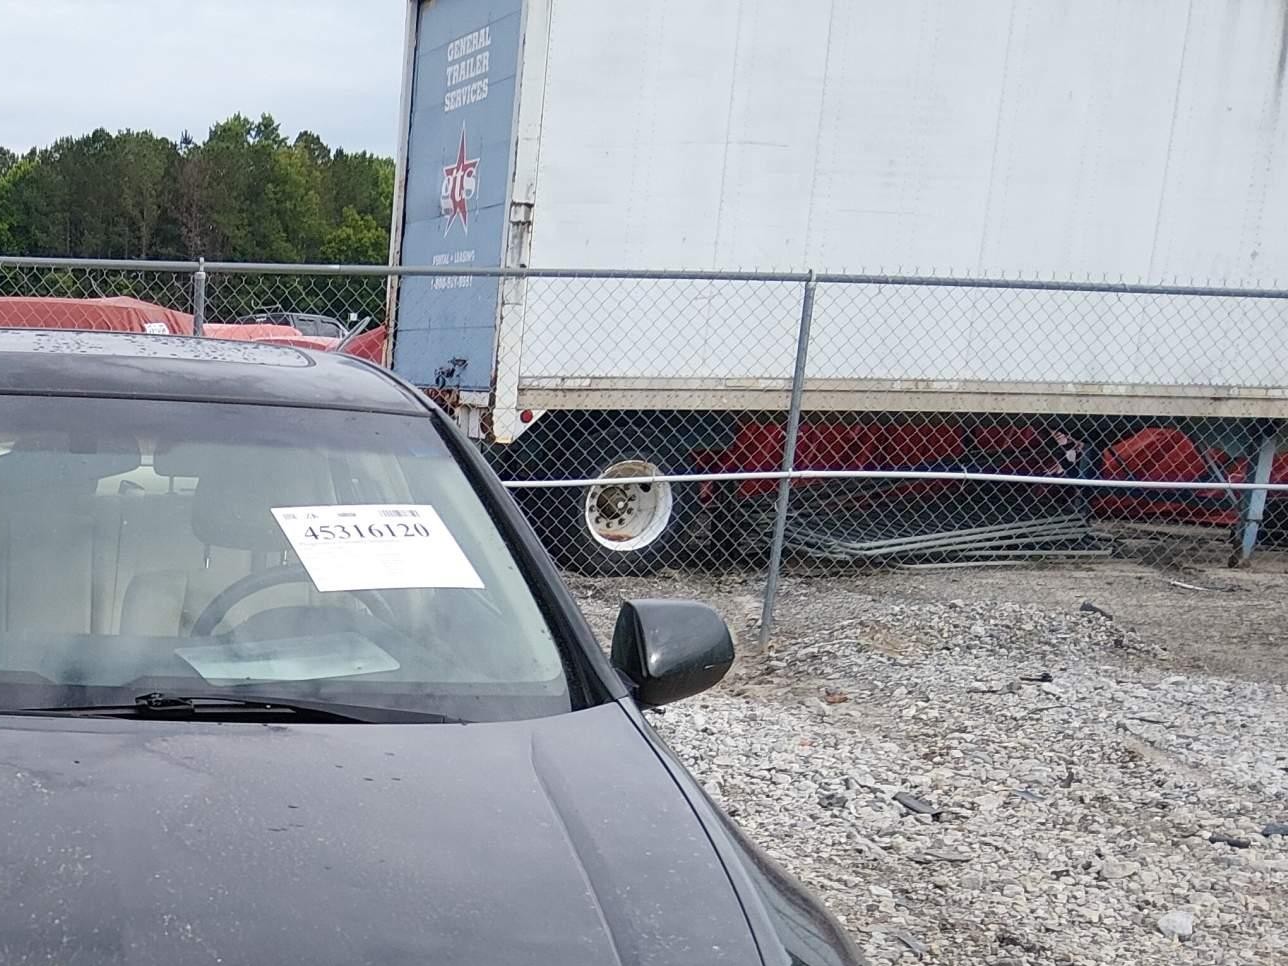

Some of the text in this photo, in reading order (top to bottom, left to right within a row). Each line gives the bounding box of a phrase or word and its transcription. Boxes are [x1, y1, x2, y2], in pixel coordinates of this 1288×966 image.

[447, 26, 491, 62] GENERAL
[446, 51, 489, 87] TRAILER
[444, 78, 489, 112] SERVICES
[304, 523, 431, 541] 45316120
